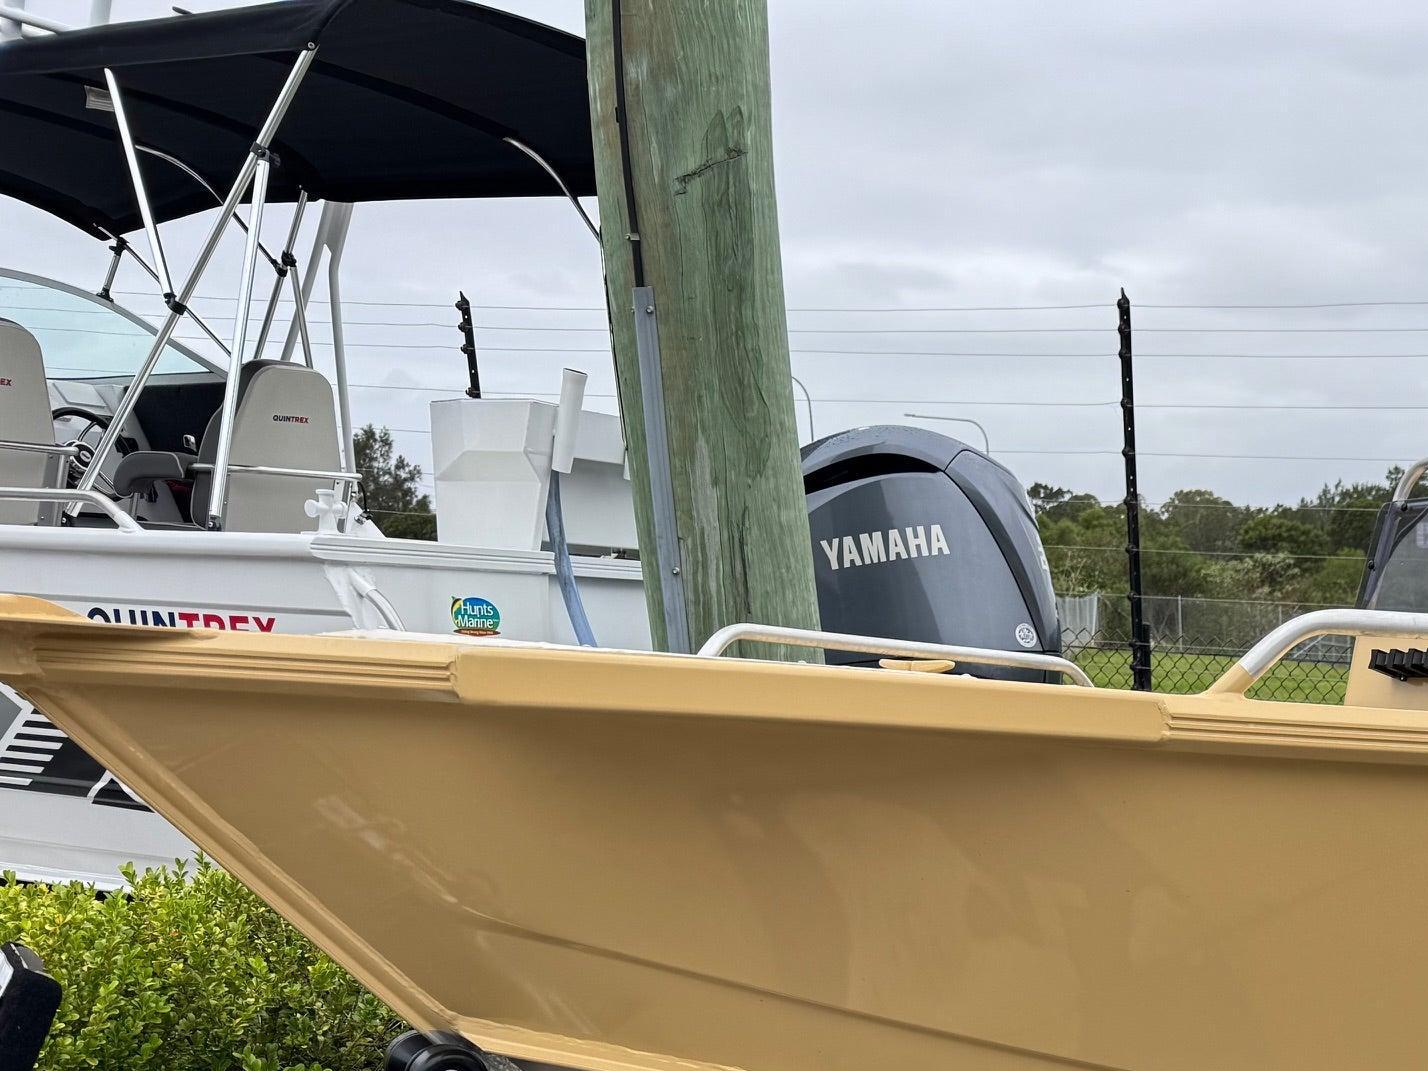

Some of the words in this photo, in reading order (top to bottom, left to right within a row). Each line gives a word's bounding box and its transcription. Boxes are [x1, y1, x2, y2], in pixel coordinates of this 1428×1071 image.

[272, 414, 309, 424] QUINTREX
[820, 524, 950, 570] YAMAHA
[461, 602, 494, 616] Hunts
